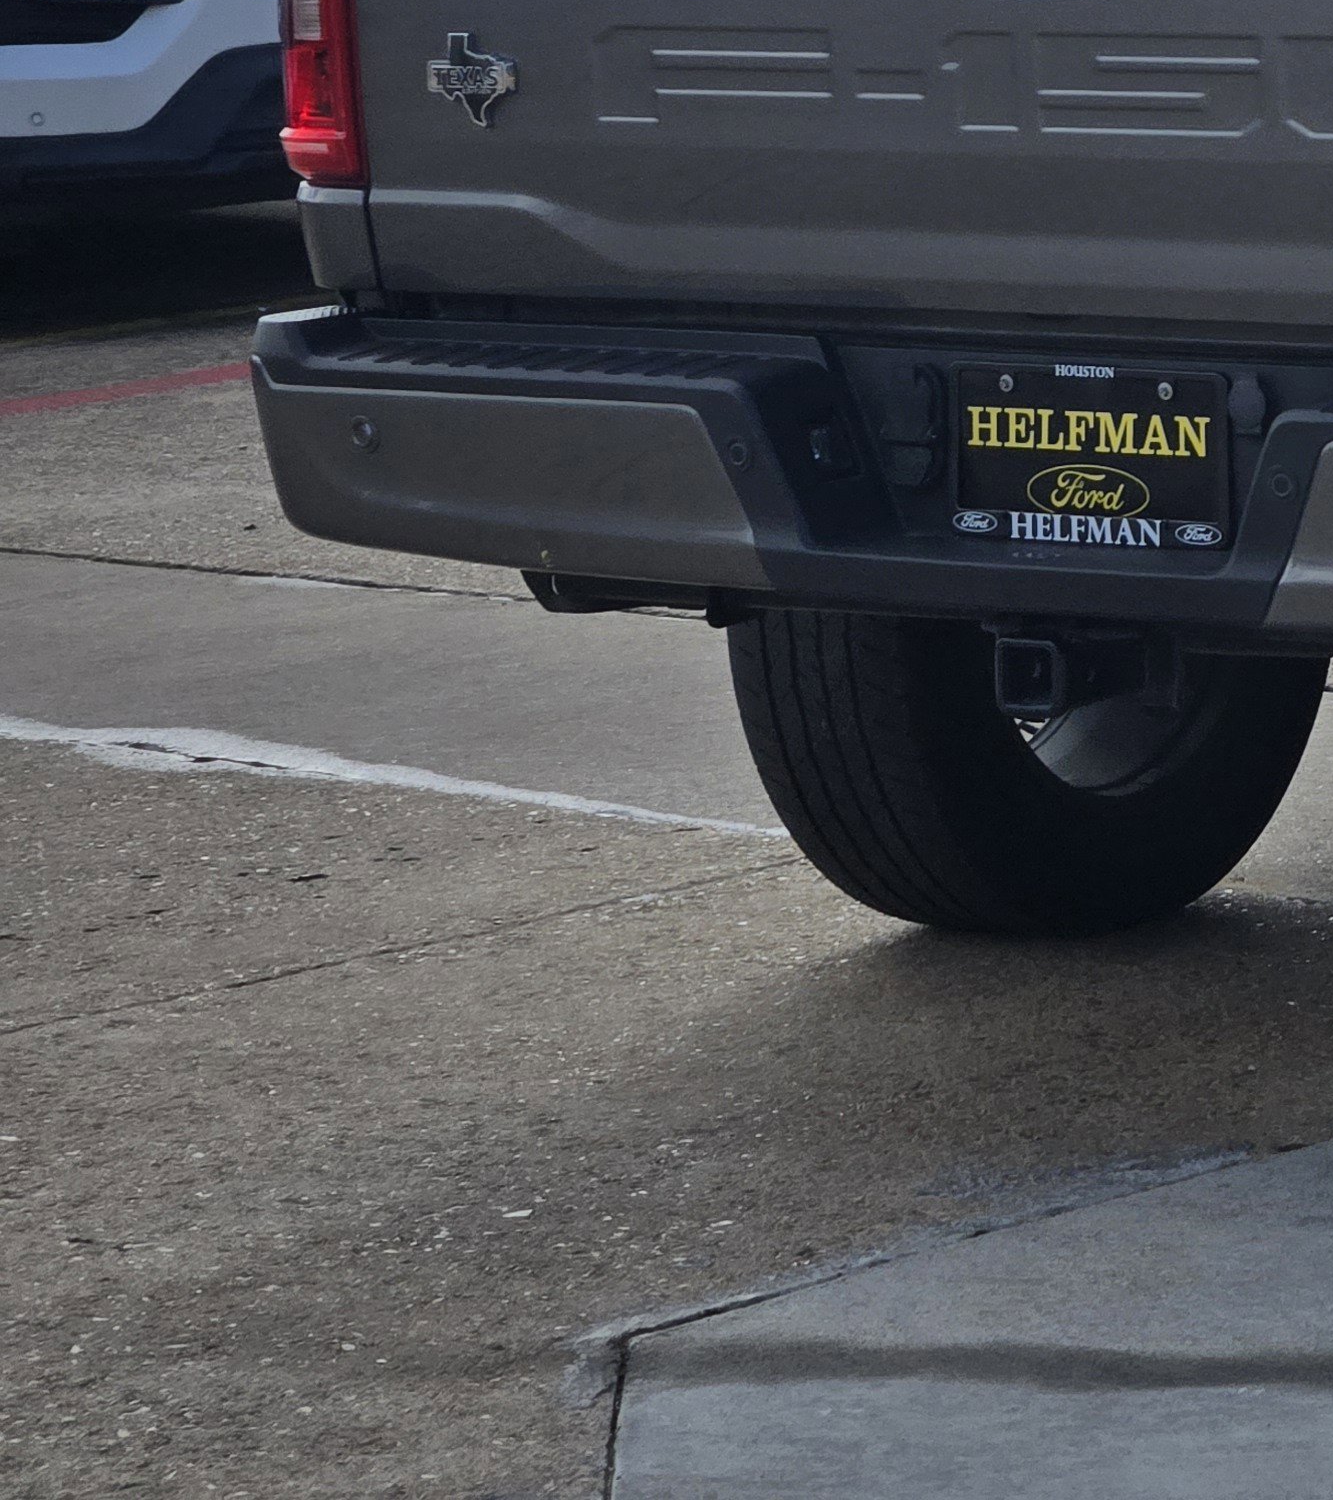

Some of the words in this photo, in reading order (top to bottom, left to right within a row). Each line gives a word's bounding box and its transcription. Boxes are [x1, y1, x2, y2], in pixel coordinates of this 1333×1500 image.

[432, 66, 498, 88] TEXAS
[1054, 364, 1115, 379] HOUSTON
[966, 405, 1211, 458] HELFMAN
[1050, 470, 1125, 511] Ford
[960, 512, 990, 529] Ford
[1010, 511, 1163, 547] HELFMAN
[1182, 525, 1214, 542] Ford
